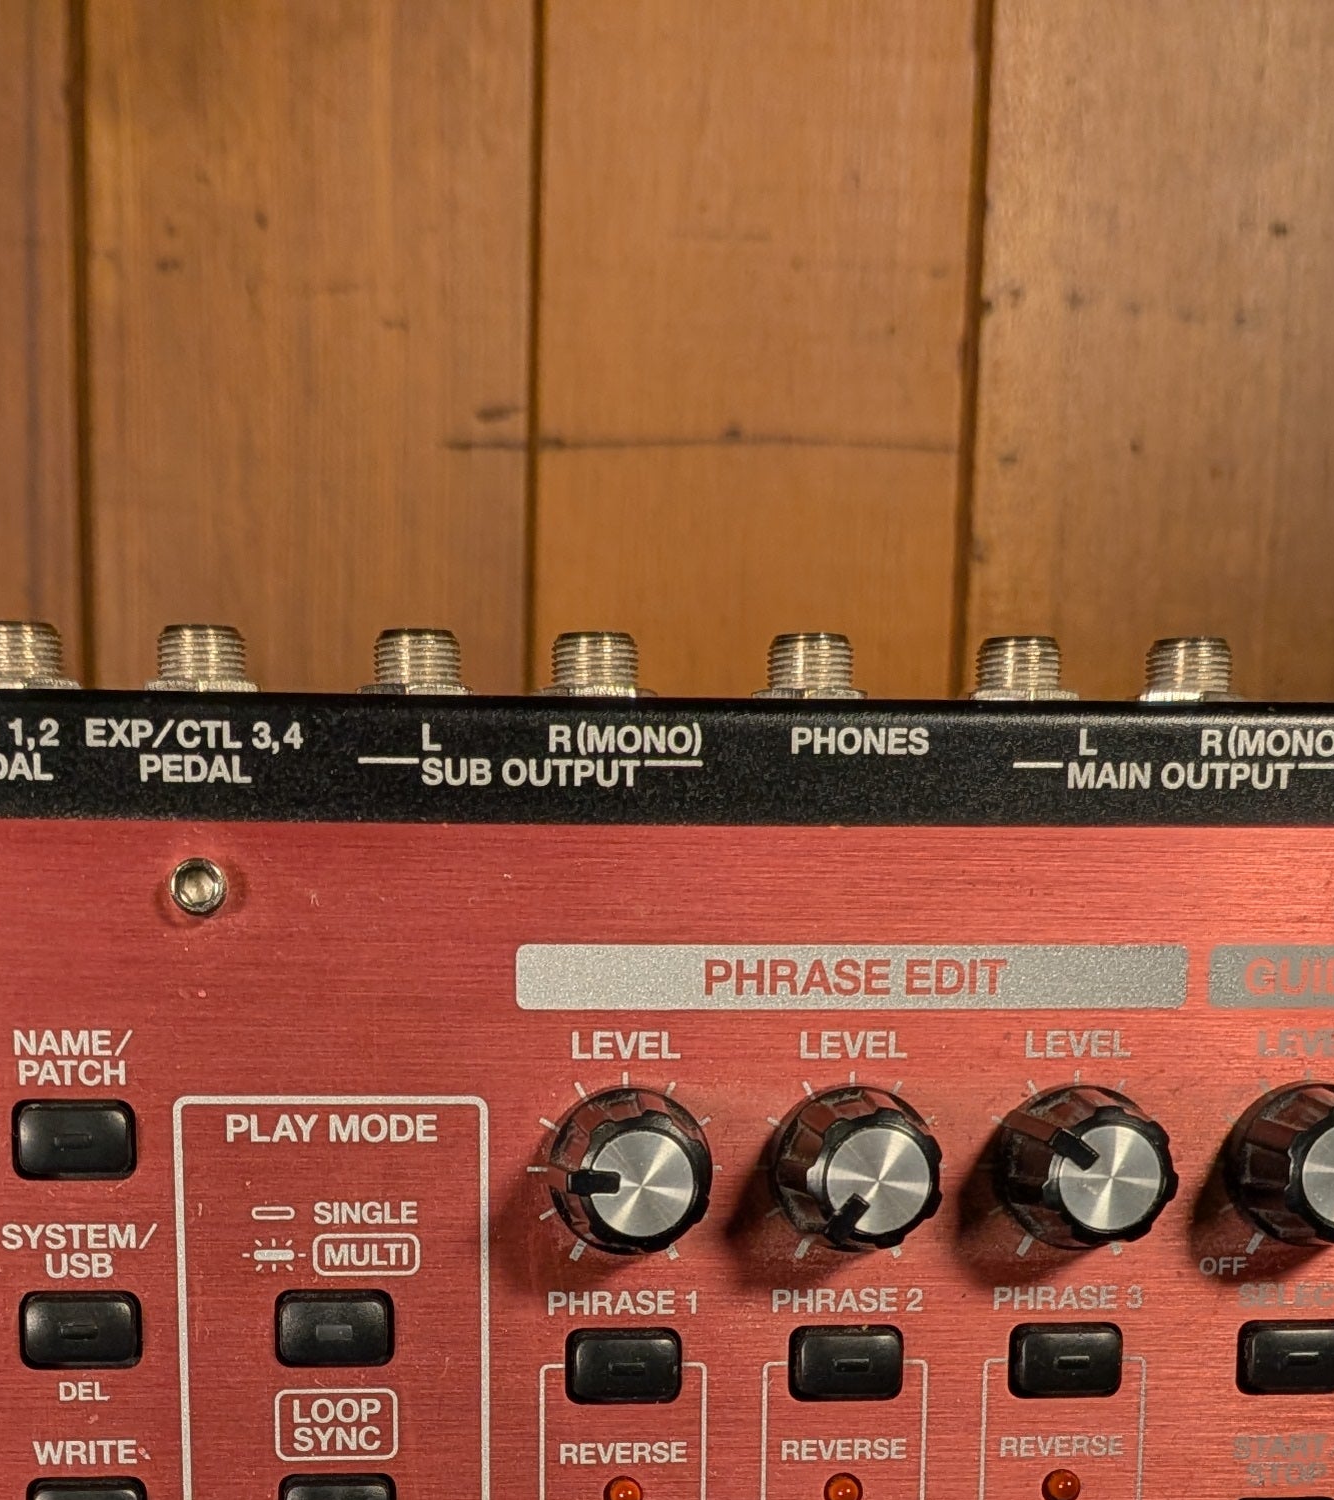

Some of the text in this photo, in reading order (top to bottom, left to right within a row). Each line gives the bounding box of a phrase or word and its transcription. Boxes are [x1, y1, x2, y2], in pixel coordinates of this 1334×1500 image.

[9, 720, 59, 751] 1,2
[85, 719, 303, 753] EXP/CTL 3,4
[422, 723, 441, 751] L
[791, 728, 930, 755] PHONES
[1078, 729, 1098, 755] L
[139, 755, 251, 784] PEDAL
[421, 758, 642, 787] SUB OUTPUT
[1067, 763, 1296, 790] MAIN OUTPUT
[704, 959, 1008, 997] PHRASE EDIT
[14, 1029, 133, 1056] NAME/
[571, 1031, 680, 1060] LEVEL
[799, 1031, 907, 1059] LEVEL
[1024, 1030, 1131, 1058] LEVEL
[18, 1060, 126, 1087] PATCH
[225, 1115, 438, 1143] PLAY MODE
[313, 1202, 418, 1224] SINGLE
[2, 1223, 157, 1250] SYSTEM/
[45, 1254, 114, 1279] USB
[324, 1244, 408, 1267] MULTI
[1199, 1257, 1248, 1276] OFF
[547, 1291, 699, 1316] PHRASE 1
[771, 1288, 924, 1314] PHRASE 2
[992, 1286, 1144, 1312] PHRASE 3
[59, 1381, 109, 1402] DEL
[292, 1399, 382, 1424] LOOP
[293, 1427, 382, 1451] SYNC
[780, 1440, 907, 1461] REVERSE
[999, 1436, 1123, 1458] REVERSE
[34, 1440, 138, 1465] WRITE
[559, 1443, 687, 1465] REVERSE
